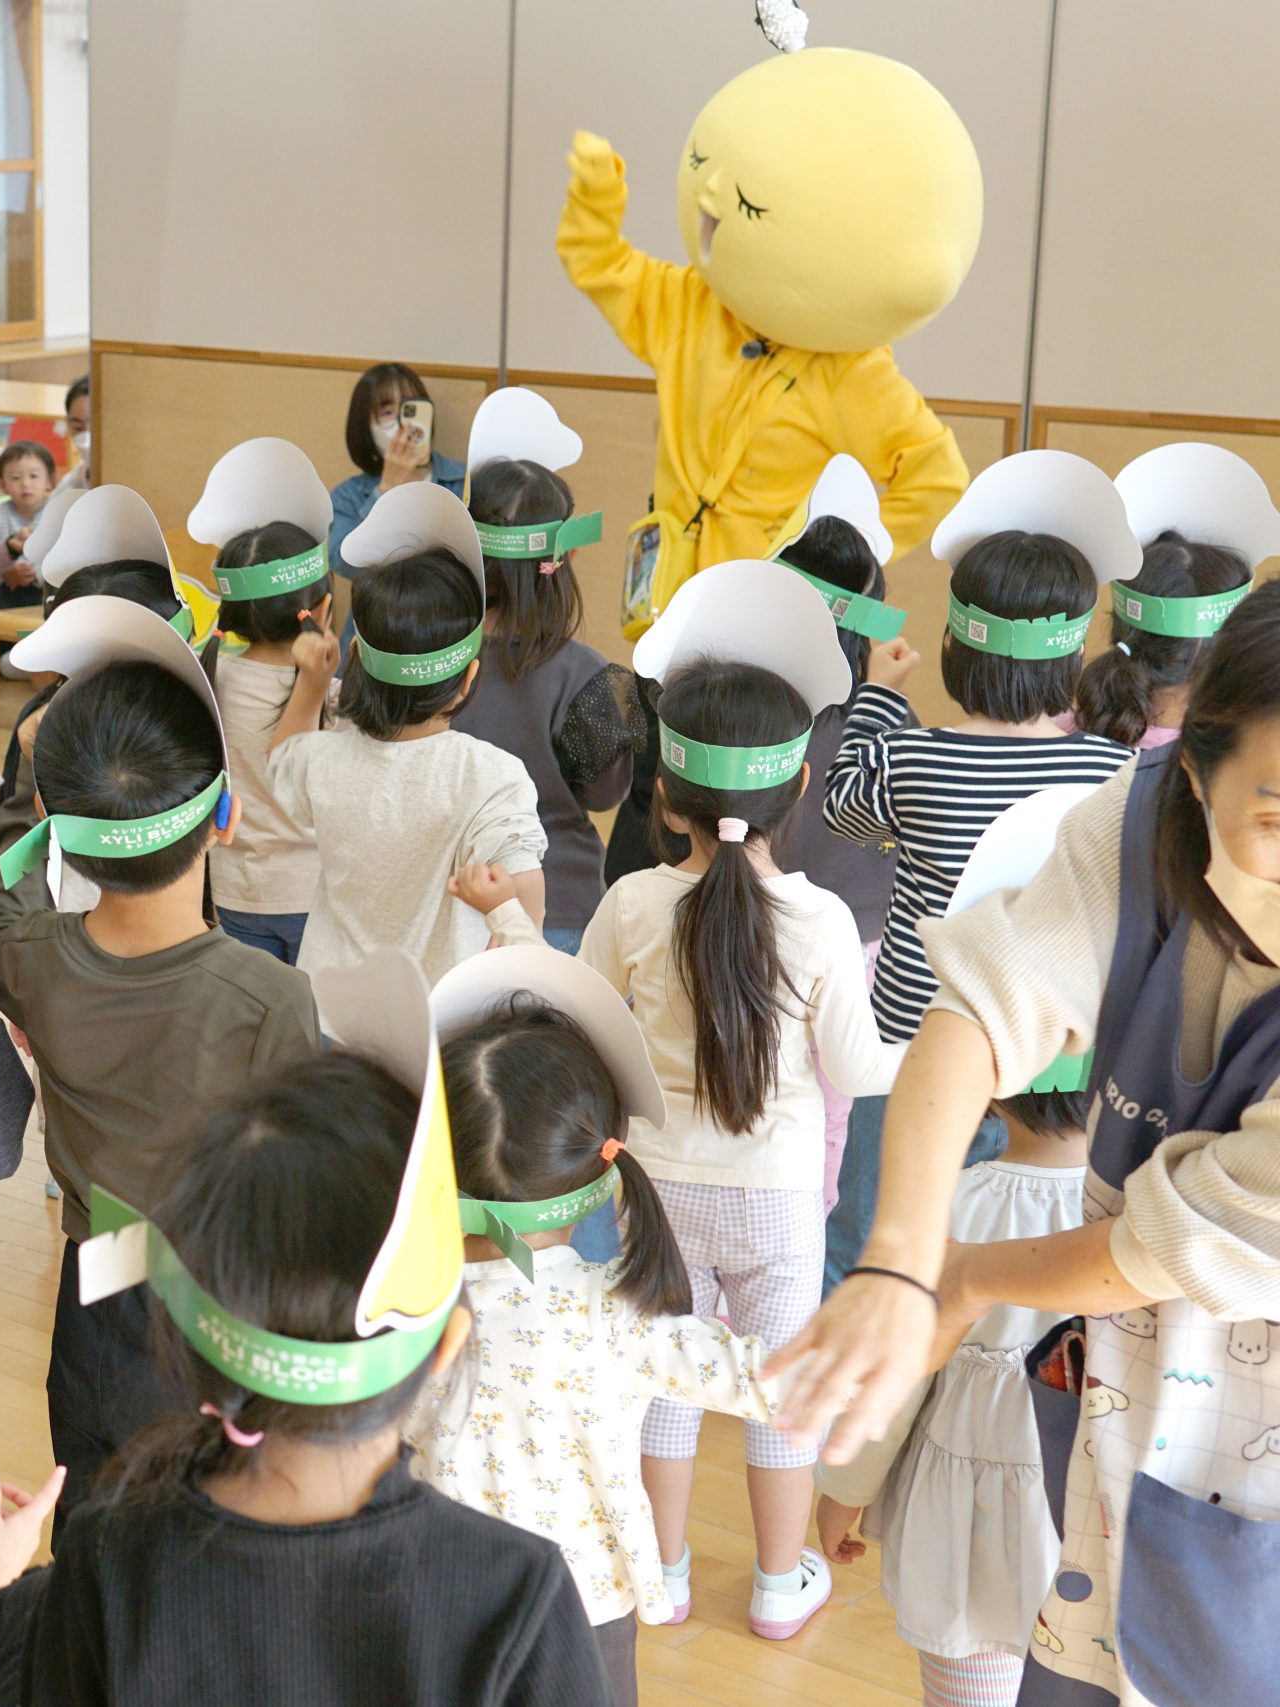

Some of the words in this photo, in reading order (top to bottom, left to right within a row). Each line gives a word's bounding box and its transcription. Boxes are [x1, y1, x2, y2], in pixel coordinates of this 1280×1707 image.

[271, 570, 296, 584] XYLI
[1197, 608, 1226, 620] XYLI
[1046, 634, 1072, 646] XYLI
[401, 665, 431, 675] XYLI
[434, 645, 473, 672] BLOCK
[746, 762, 778, 775] XYLI
[99, 834, 142, 845] XYLI
[148, 802, 207, 840] BLOCK
[536, 1203, 579, 1222] XYLI
[250, 1353, 360, 1384] BLOCK
